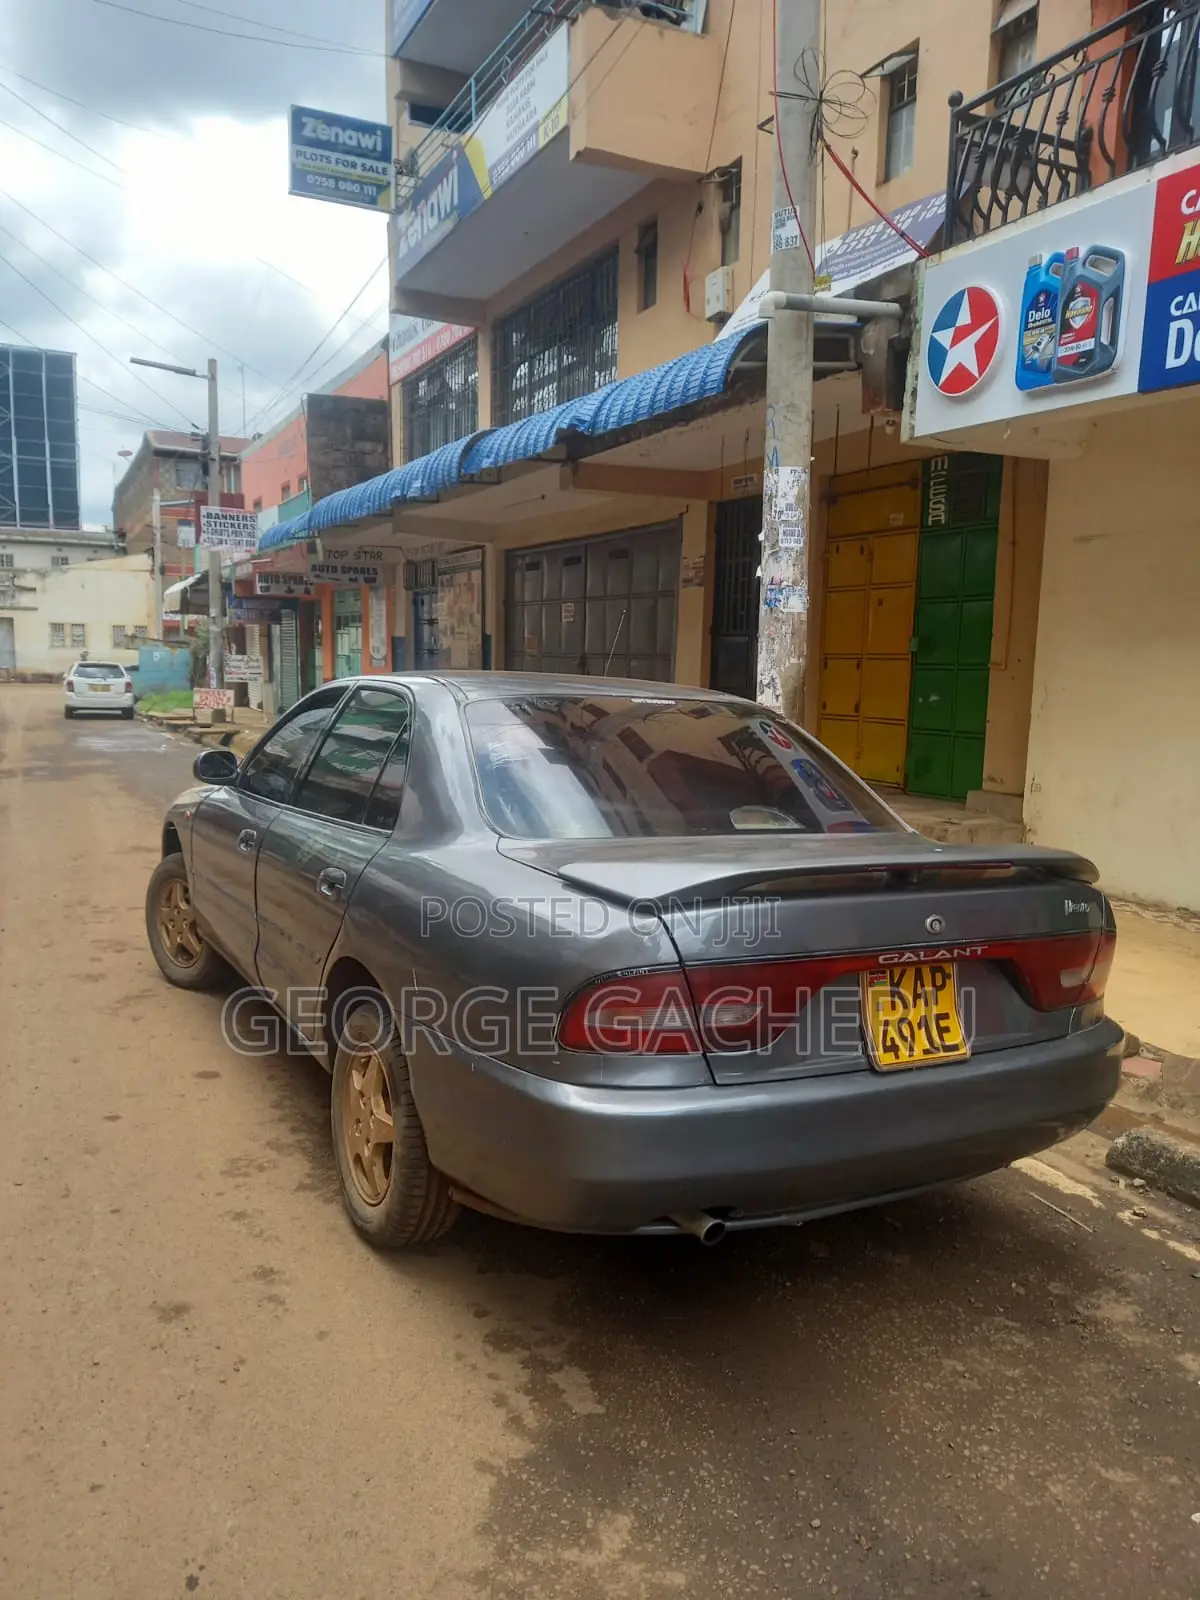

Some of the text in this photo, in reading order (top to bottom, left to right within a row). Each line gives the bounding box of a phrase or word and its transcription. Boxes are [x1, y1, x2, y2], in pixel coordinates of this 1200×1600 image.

[295, 149, 333, 164] PLOTS
[335, 157, 358, 170] FOR
[360, 161, 388, 175] SALE
[1181, 188, 1200, 215] C
[1175, 219, 1200, 265] H
[1028, 307, 1051, 323] Delo
[206, 511, 256, 523] BANNERS
[206, 520, 256, 531] STICKERS
[327, 549, 384, 561] TOP STAR
[311, 564, 379, 576] AUTO SPARES
[258, 574, 281, 585] AUTO
[878, 945, 989, 964] GALANT
[889, 964, 948, 1011] KAP
[881, 1012, 959, 1060] 491E
